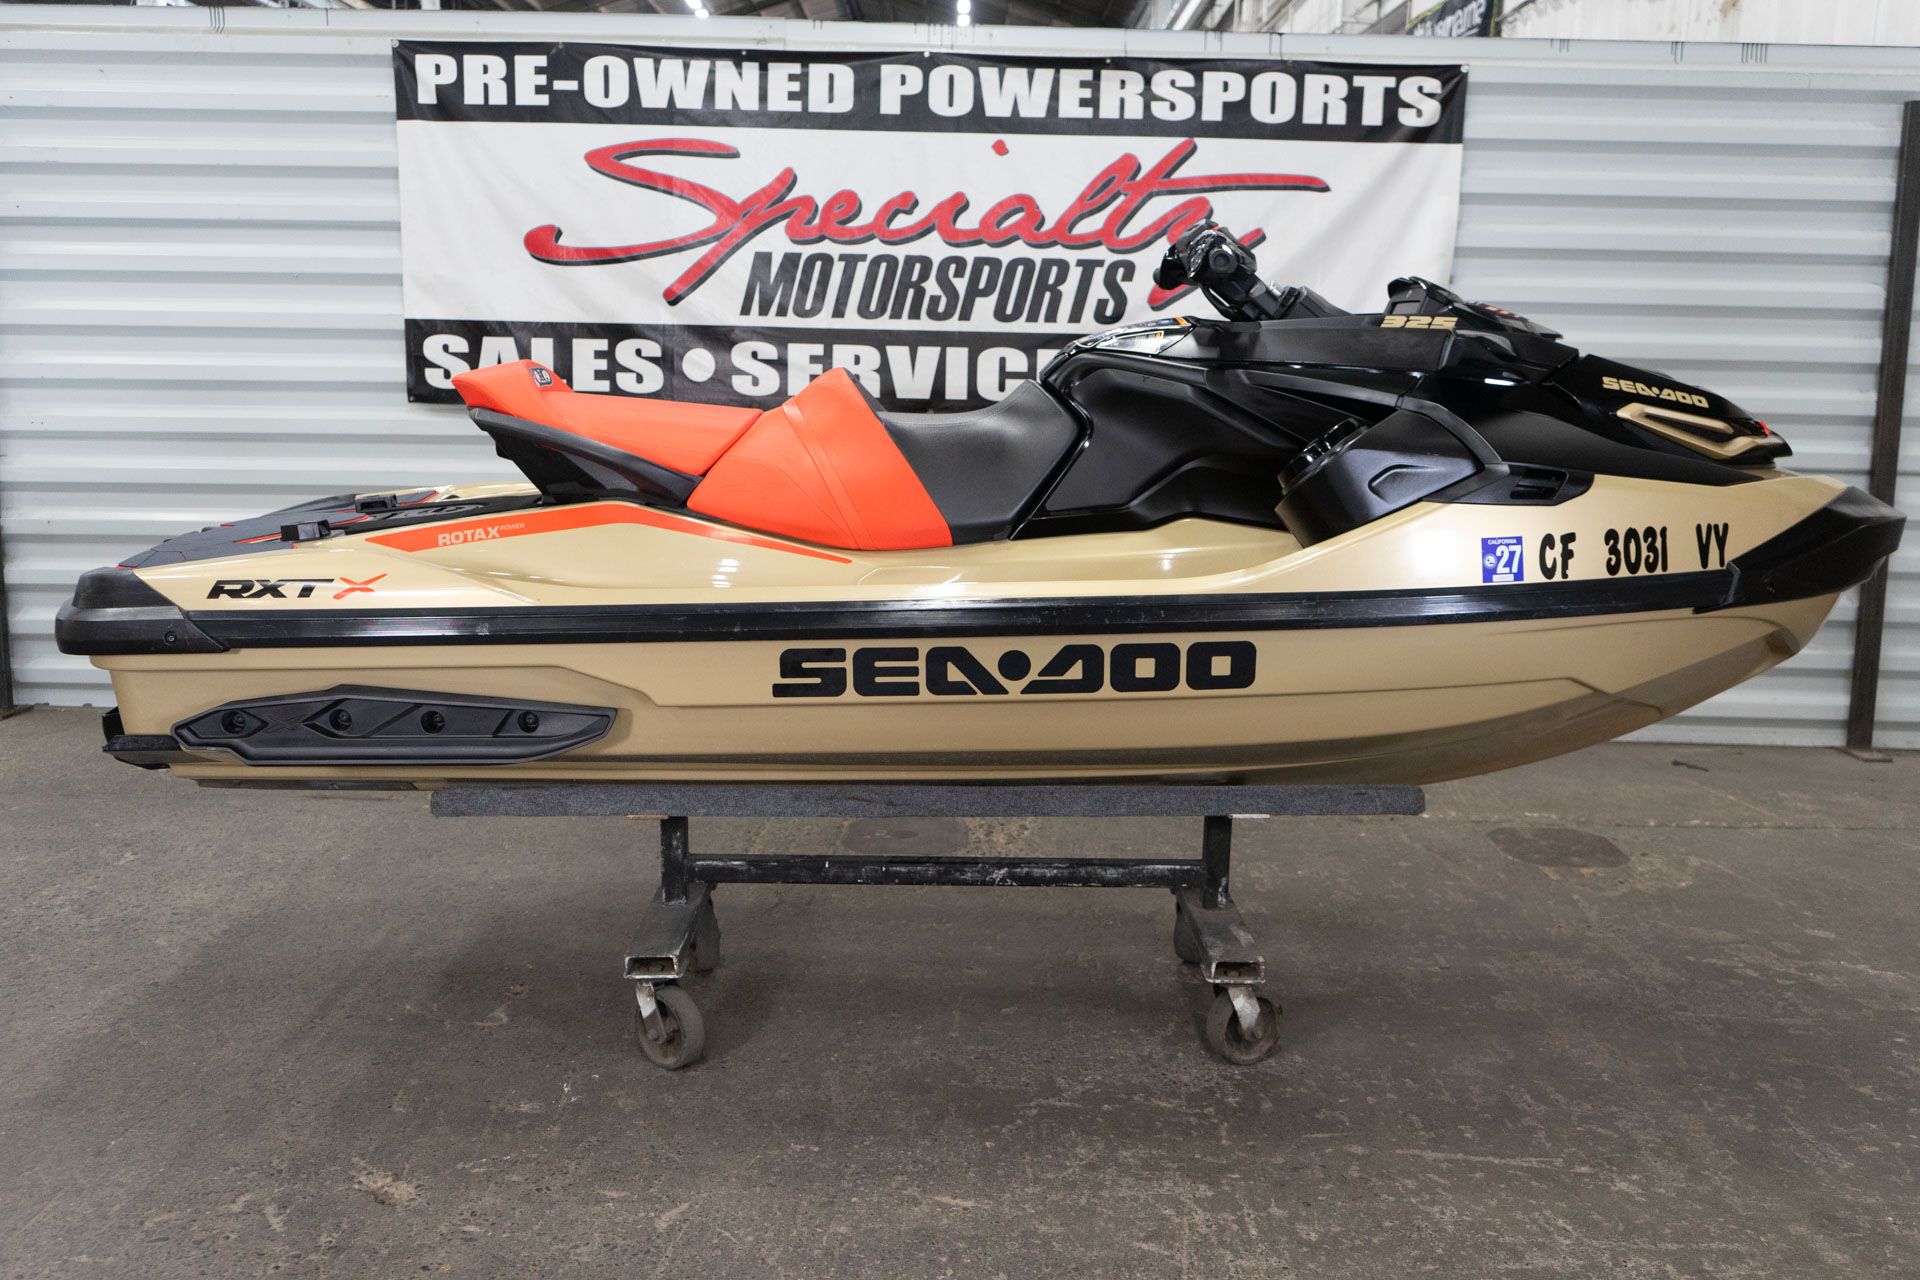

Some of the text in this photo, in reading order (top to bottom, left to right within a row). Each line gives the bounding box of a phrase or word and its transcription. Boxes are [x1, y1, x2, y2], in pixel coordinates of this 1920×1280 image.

[415, 54, 1442, 127] PRE-OWNED POWERSPORTS
[523, 137, 1331, 310] Specialty
[740, 251, 1135, 324] MOTORSPORTS
[1380, 315, 1458, 328] 325
[437, 526, 500, 546] ROTAX
[1495, 544, 1522, 574] 27
[1539, 523, 1728, 579] CF 3031 VY
